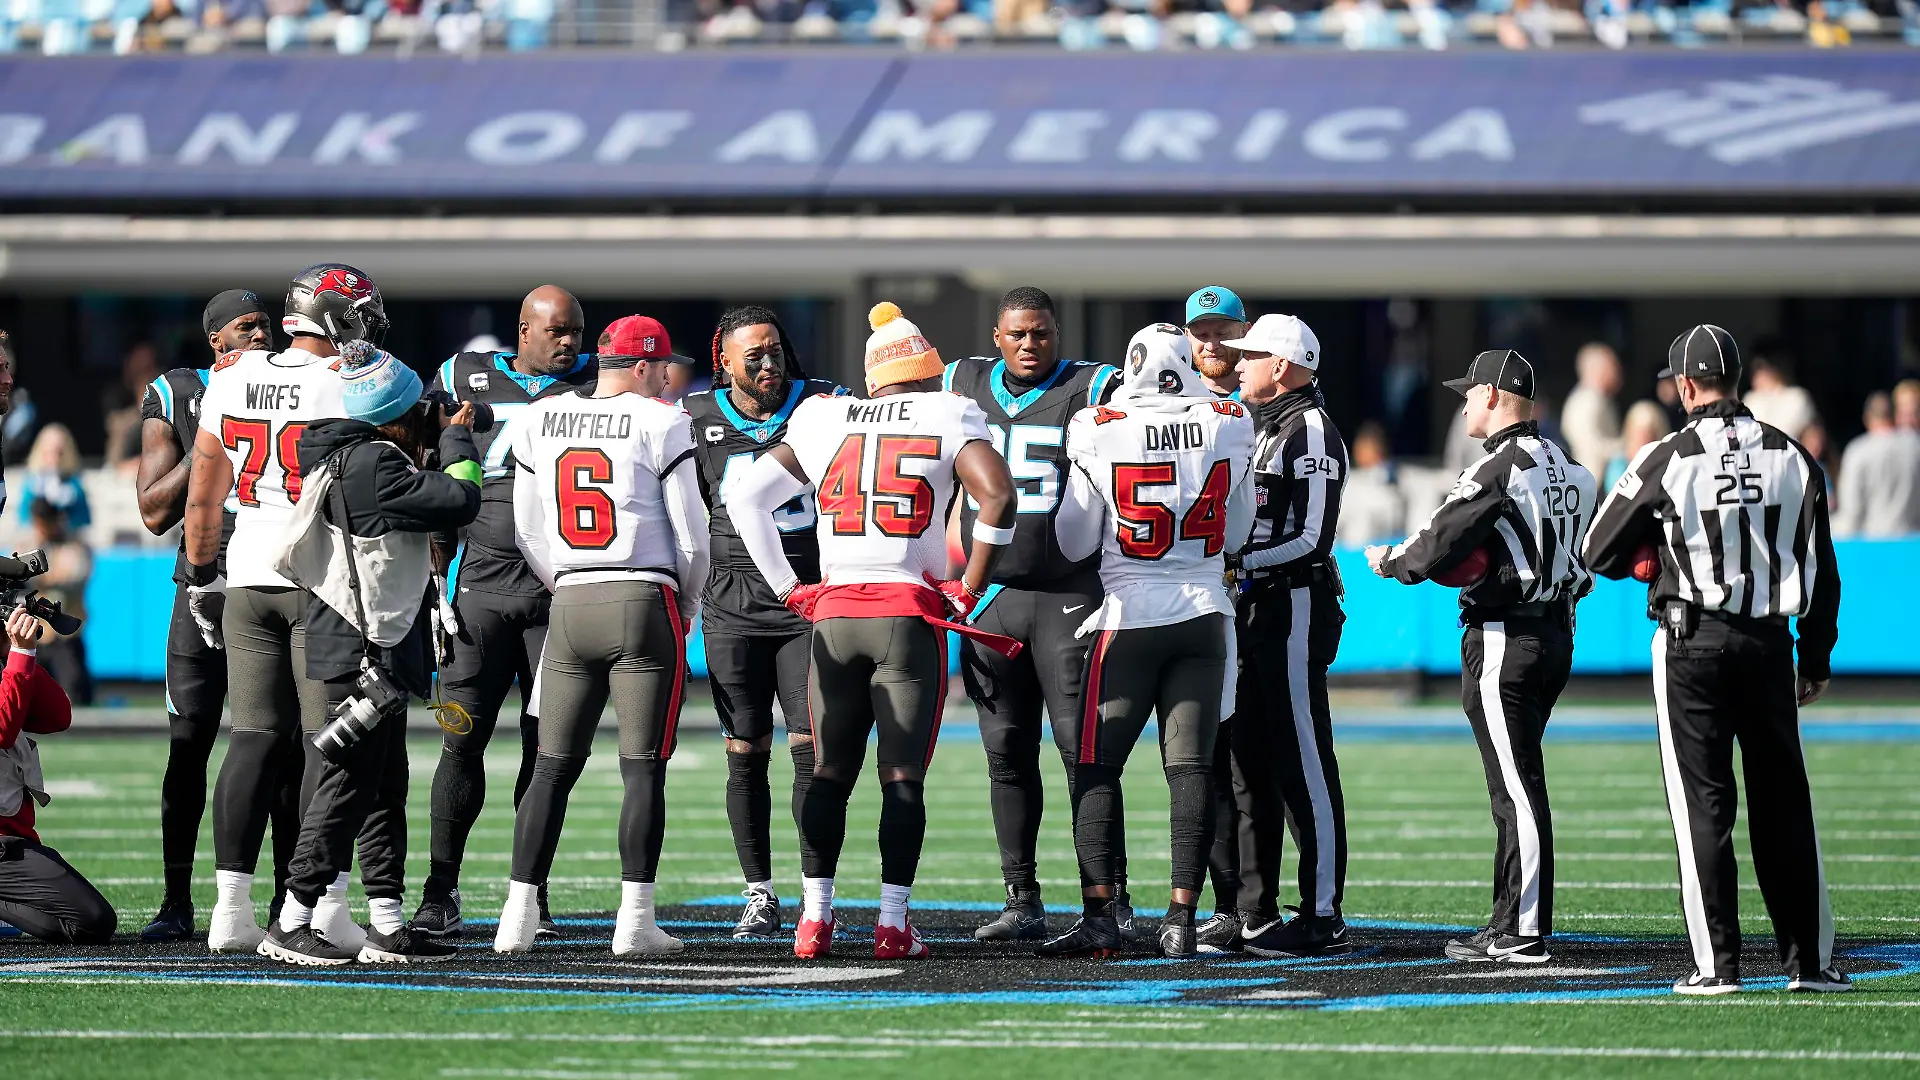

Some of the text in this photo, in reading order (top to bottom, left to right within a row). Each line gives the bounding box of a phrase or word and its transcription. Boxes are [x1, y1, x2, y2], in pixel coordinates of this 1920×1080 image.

[466, 111, 694, 166] OF
[715, 108, 1515, 164] AMERICA
[246, 383, 301, 410] WIRFS
[541, 412, 632, 439] MAYFIELD
[846, 401, 914, 423] WHITE
[1094, 407, 1128, 426] 4
[1145, 422, 1203, 451] DAVID
[1303, 457, 1332, 475] 34
[1546, 467, 1567, 484] BJ
[1720, 453, 1751, 471] FJ
[555, 447, 617, 550] 6
[817, 433, 942, 539] 45
[1713, 473, 1764, 505] 25
[1111, 458, 1232, 561] 54
[1542, 485, 1580, 516] 120
